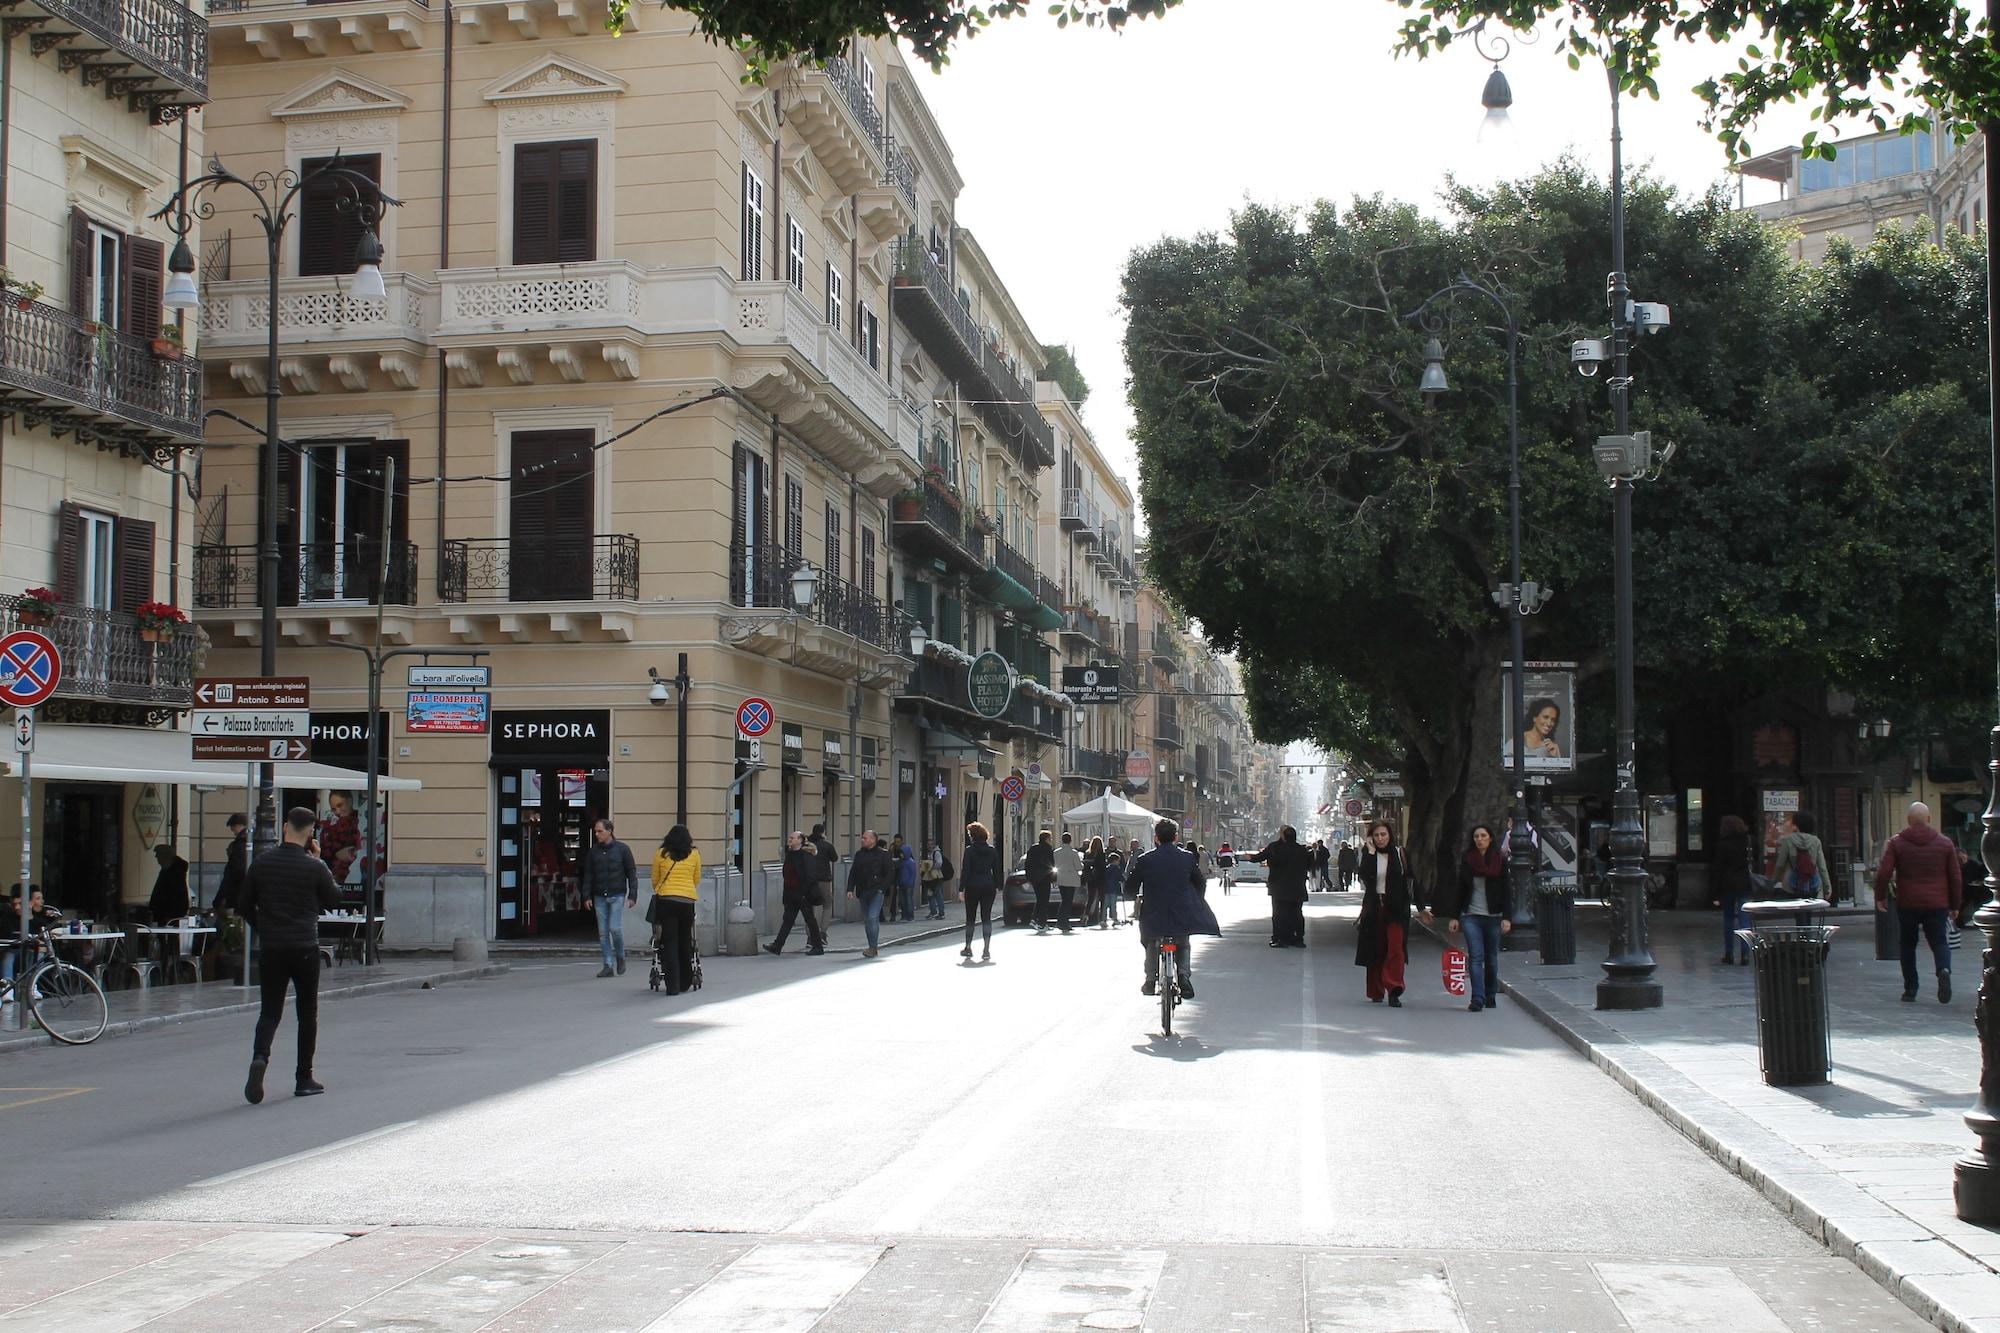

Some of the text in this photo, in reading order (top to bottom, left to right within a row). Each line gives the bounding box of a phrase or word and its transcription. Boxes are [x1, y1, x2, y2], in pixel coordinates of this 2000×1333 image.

[423, 674, 442, 682] bara
[445, 674, 484, 682] all'olivella
[971, 674, 1008, 684] MASSIMO
[977, 685, 1002, 695] PLAZA
[237, 695, 305, 704] Antonio Salinas
[412, 695, 483, 703] DAL POMPIERE
[976, 696, 1004, 706] HOTEL
[224, 715, 294, 732] Palazzo Branciforte
[503, 723, 596, 739] SEPHORA
[901, 767, 914, 784] FRAU
